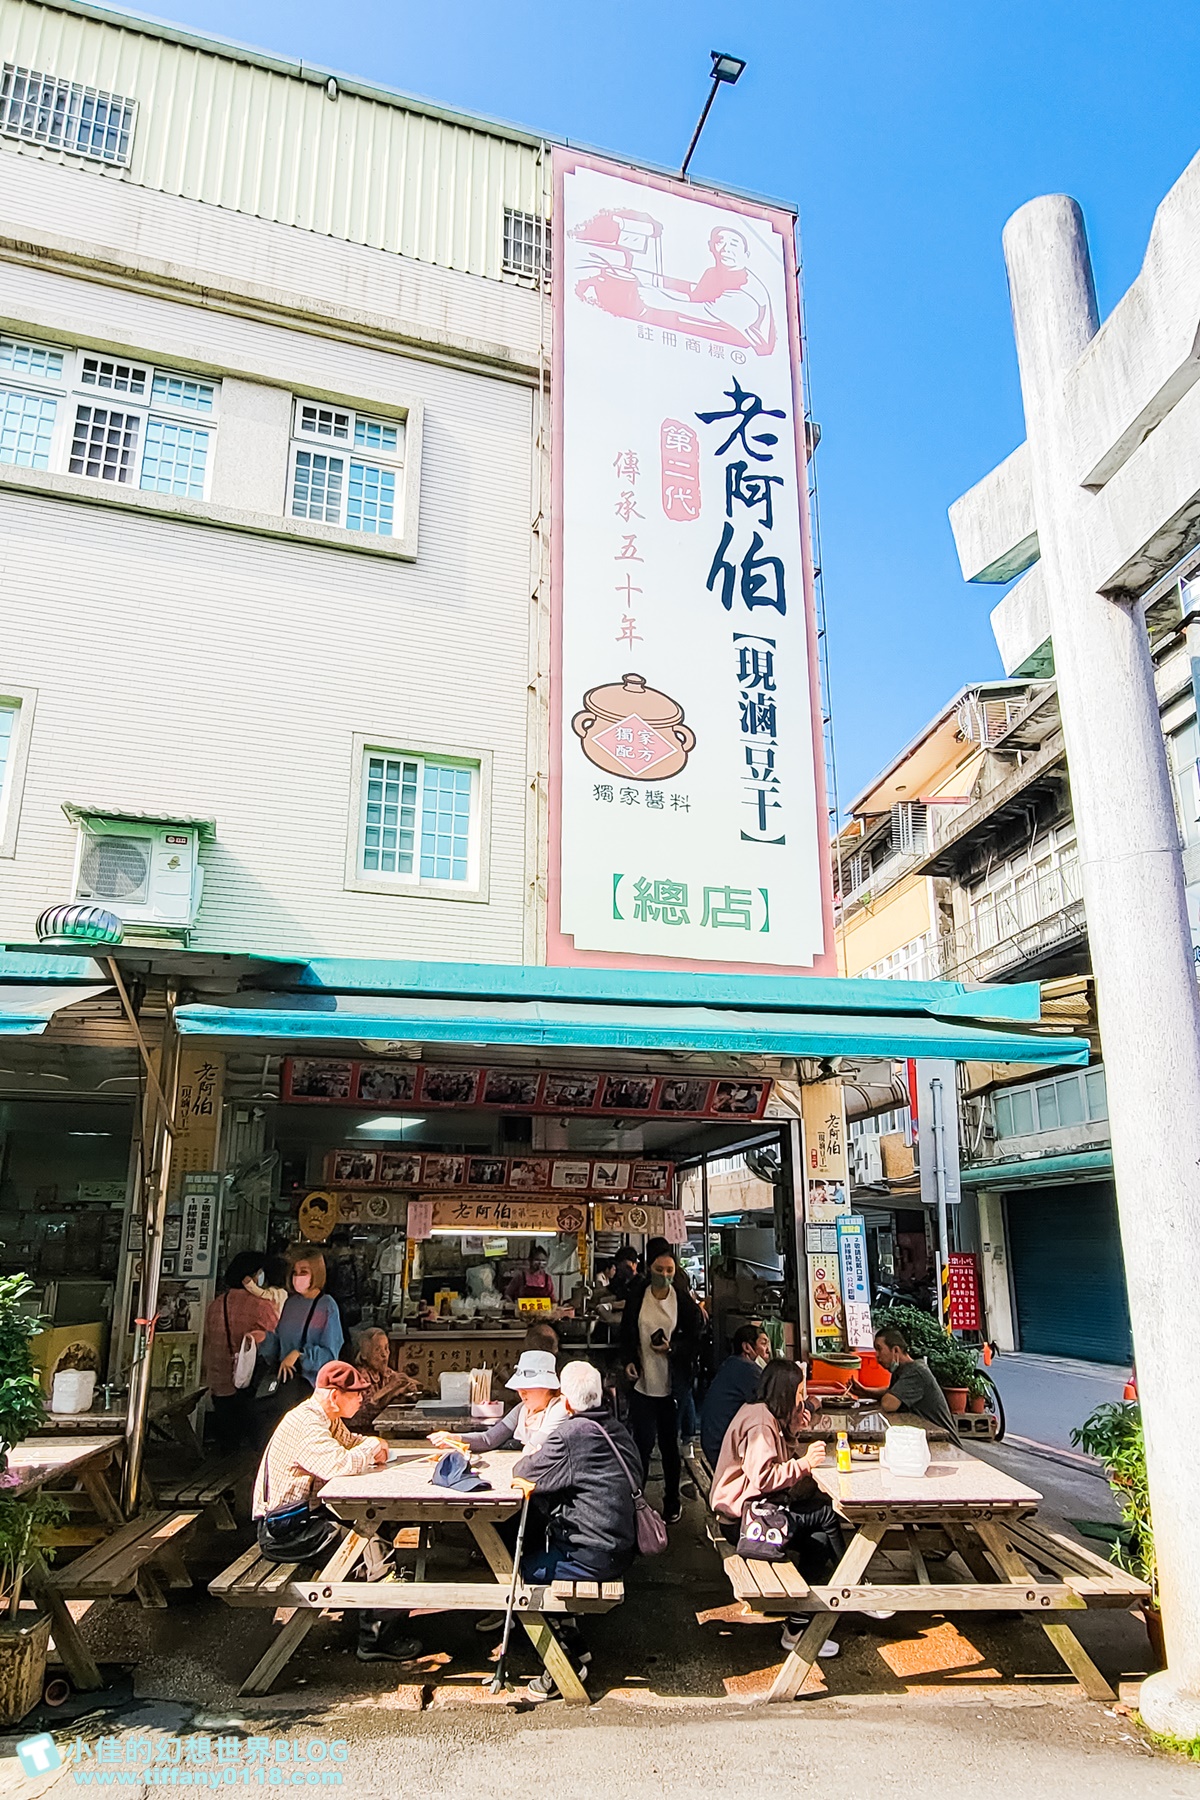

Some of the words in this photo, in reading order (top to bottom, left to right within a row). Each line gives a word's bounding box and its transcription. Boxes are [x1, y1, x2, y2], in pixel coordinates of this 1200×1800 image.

[662, 425, 697, 518] 第二代
[694, 375, 788, 616] 老阿伯
[612, 450, 646, 651] 傳承五十年
[592, 783, 692, 813] 獨家醬料
[613, 873, 770, 933] 【總店】
[192, 1061, 218, 1116] 老阿伯
[825, 1113, 841, 1155] 老阿伯
[452, 1201, 512, 1220] 老阿伯
